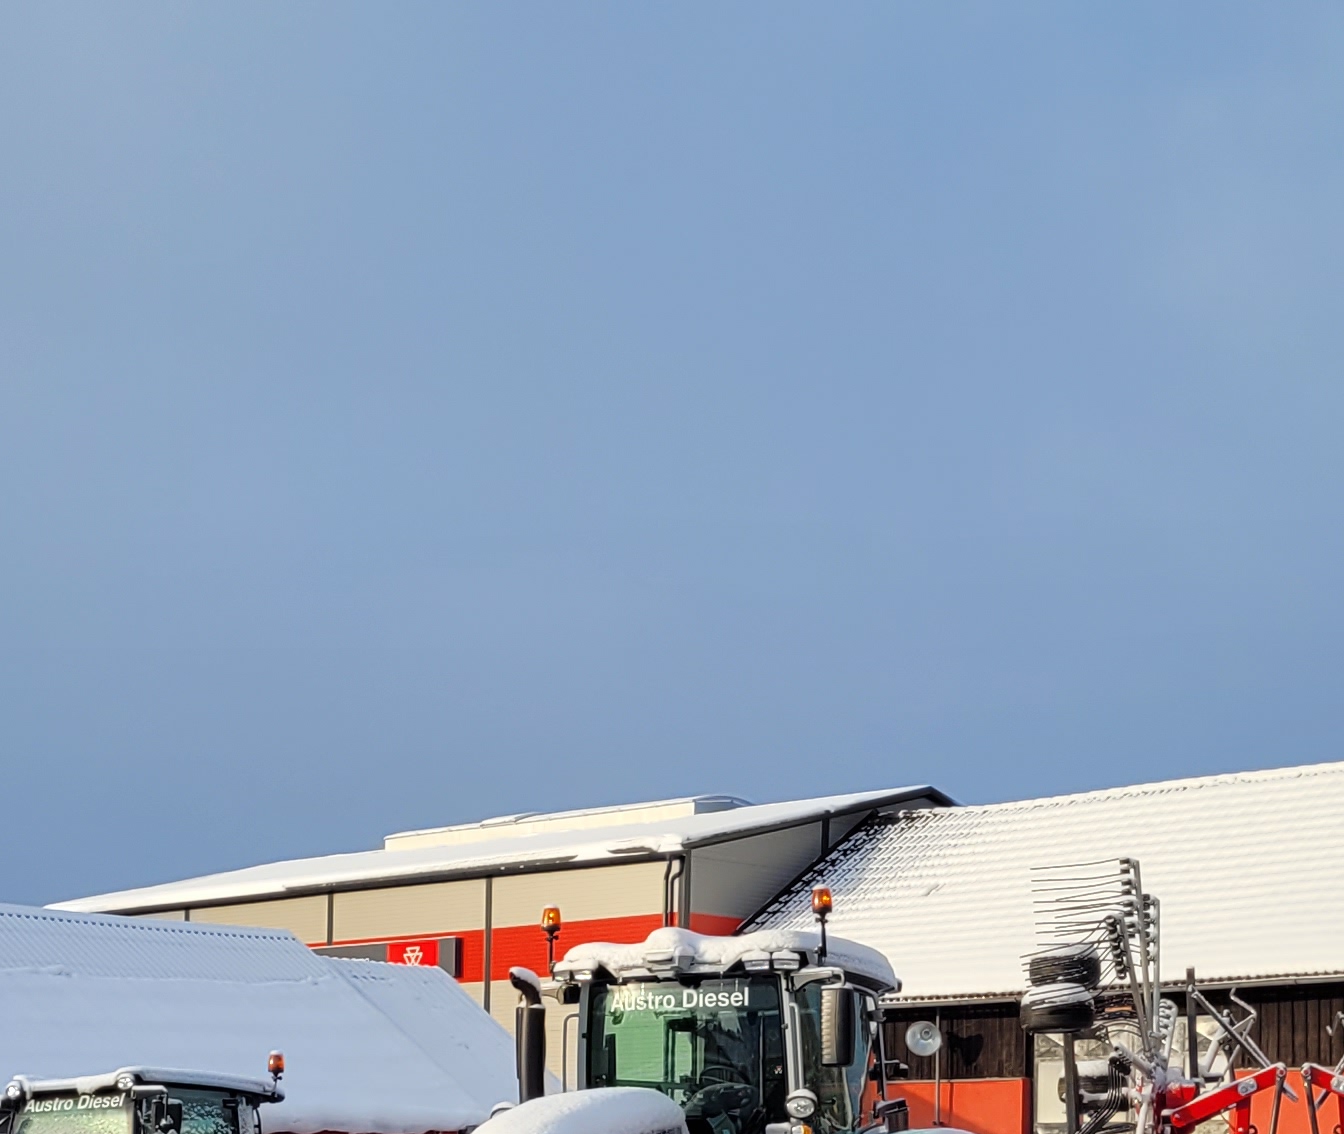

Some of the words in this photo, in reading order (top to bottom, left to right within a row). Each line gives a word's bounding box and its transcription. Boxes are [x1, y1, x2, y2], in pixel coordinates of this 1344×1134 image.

[610, 992, 676, 1012] Austro
[682, 987, 749, 1008] Diesel
[23, 1097, 74, 1113] Austro
[77, 1092, 126, 1110] Diesel
